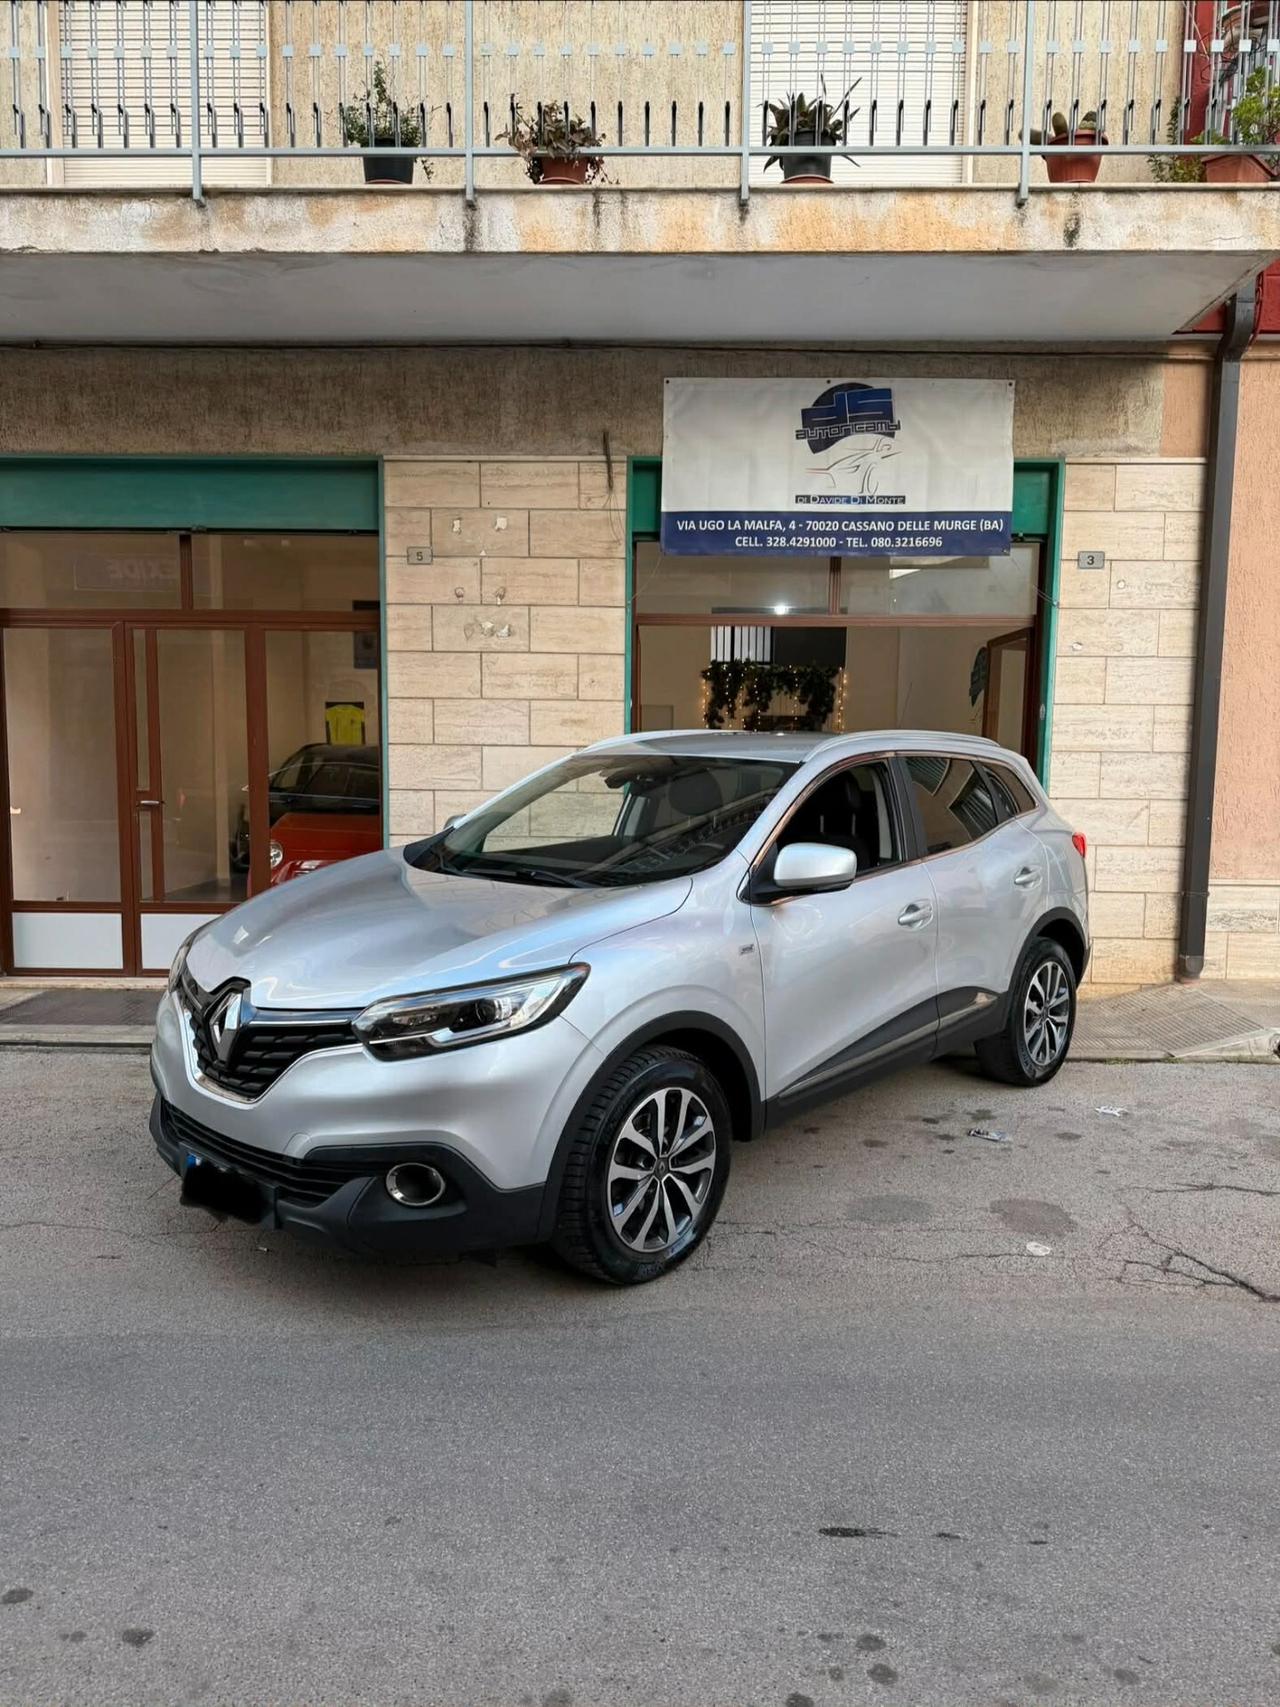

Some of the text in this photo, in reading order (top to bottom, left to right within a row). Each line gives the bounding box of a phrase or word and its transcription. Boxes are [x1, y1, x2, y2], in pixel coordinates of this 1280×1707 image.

[677, 520, 696, 531] VIA
[699, 520, 725, 531] UGO
[728, 520, 742, 531] LA
[744, 520, 786, 532] MALFA,
[788, 520, 796, 531] 4
[806, 521, 839, 531] 70020
[841, 521, 894, 532] CASSANO
[897, 520, 930, 531] DELLE
[933, 520, 977, 531] MURGE
[979, 519, 1004, 532] (BA)
[735, 536, 763, 547] CELL.
[766, 537, 836, 547] 328.4291000
[846, 537, 868, 548] TEL.
[871, 537, 943, 548] 080.3216696
[416, 551, 423, 561] 5
[1087, 555, 1095, 566] 3
